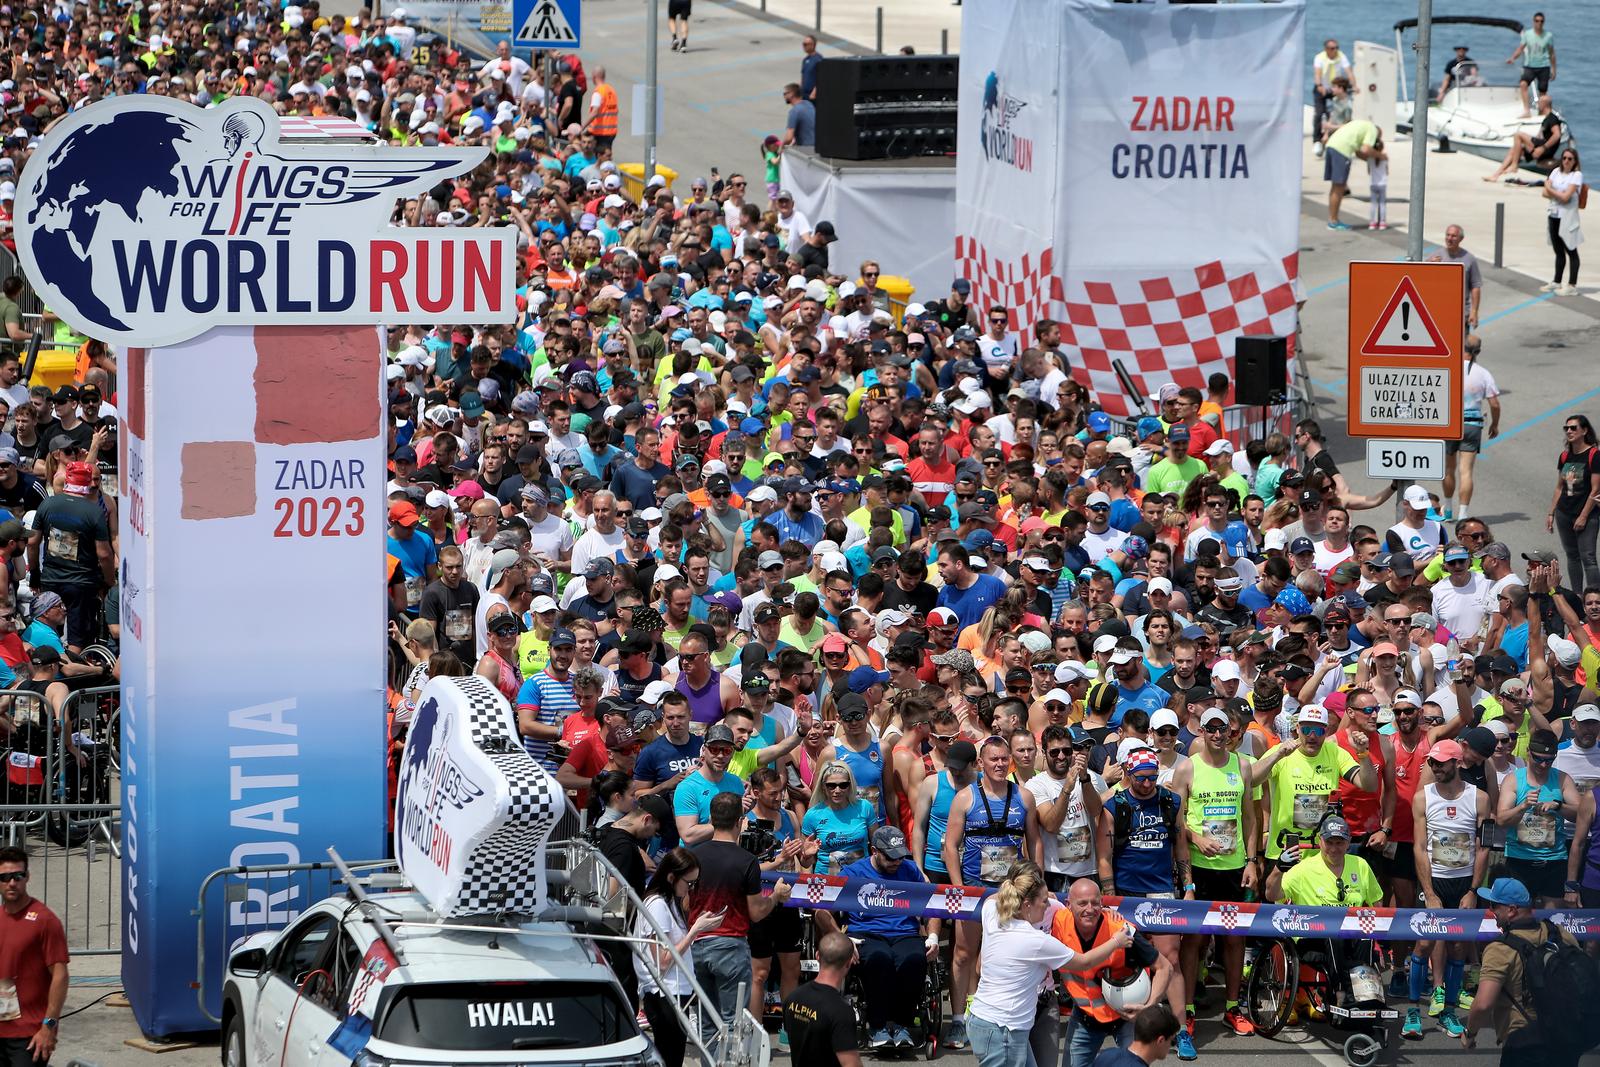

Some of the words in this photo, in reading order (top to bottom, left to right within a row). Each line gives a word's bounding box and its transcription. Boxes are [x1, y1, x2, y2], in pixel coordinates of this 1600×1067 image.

[1130, 96, 1235, 132] ZADAR
[1112, 143, 1250, 179] CROATIA
[181, 153, 350, 199] WINGS
[170, 202, 206, 217] FOR
[201, 202, 301, 236] LIFE
[112, 239, 357, 313] WORLD
[369, 239, 503, 313] RUN
[1369, 373, 1442, 388] ULAZ/IZLAZ
[1374, 389, 1416, 403] VOZILA
[1421, 391, 1436, 403] SA
[1381, 450, 1407, 468] 50
[1413, 455, 1430, 469] m
[275, 459, 366, 491] ZADAR
[273, 496, 366, 538] 2023
[1295, 783, 1332, 794] respect.
[126, 685, 140, 956] CROATIA
[228, 696, 301, 951] ROATIA
[404, 796, 434, 857] WORLD
[430, 822, 453, 877] RUN
[867, 897, 894, 908] WORLD
[894, 899, 910, 909] RUN
[1144, 915, 1172, 926] WORLD
[1171, 917, 1188, 926] RUN
[1282, 922, 1310, 931] WORLD
[1420, 924, 1448, 934] WORLD
[467, 1002, 556, 1028] HVALA!
[788, 1001, 818, 1021] ALPHA
